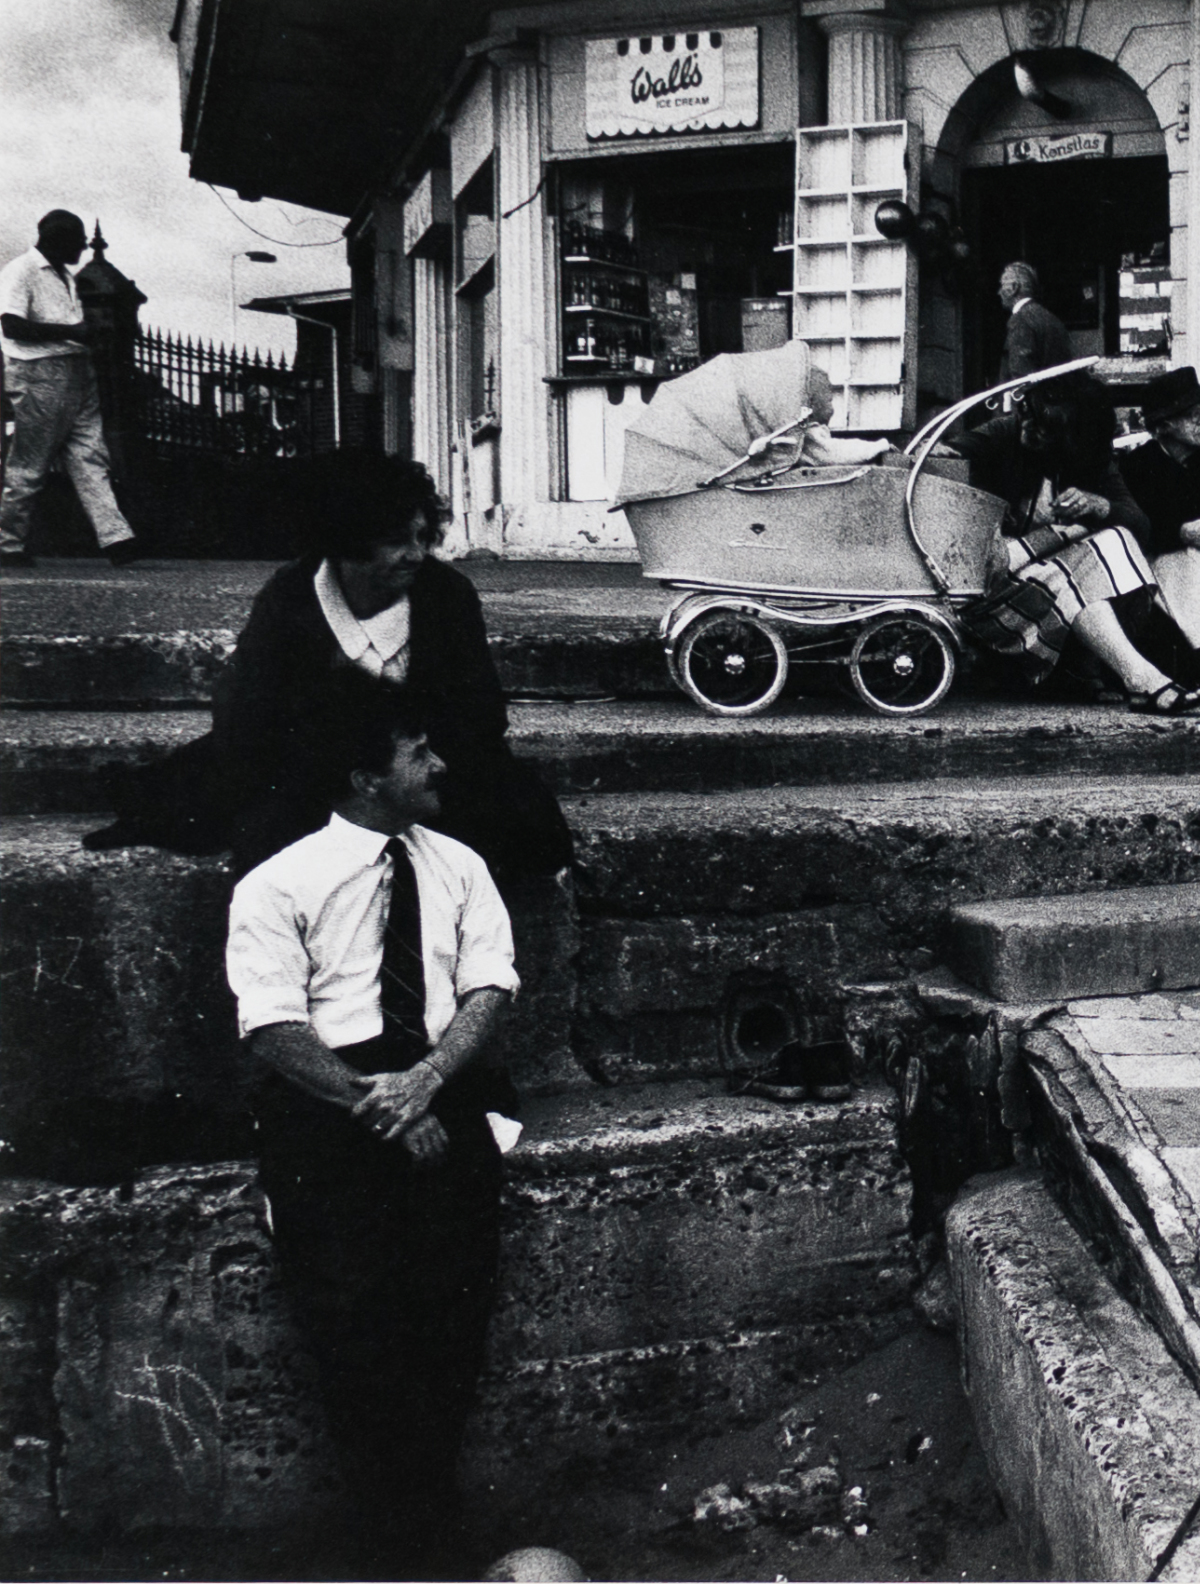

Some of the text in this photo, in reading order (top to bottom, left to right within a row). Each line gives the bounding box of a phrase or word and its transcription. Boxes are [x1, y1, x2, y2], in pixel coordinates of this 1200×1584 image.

[631, 53, 703, 104] Wall's
[656, 97, 709, 108] ICE CREAM
